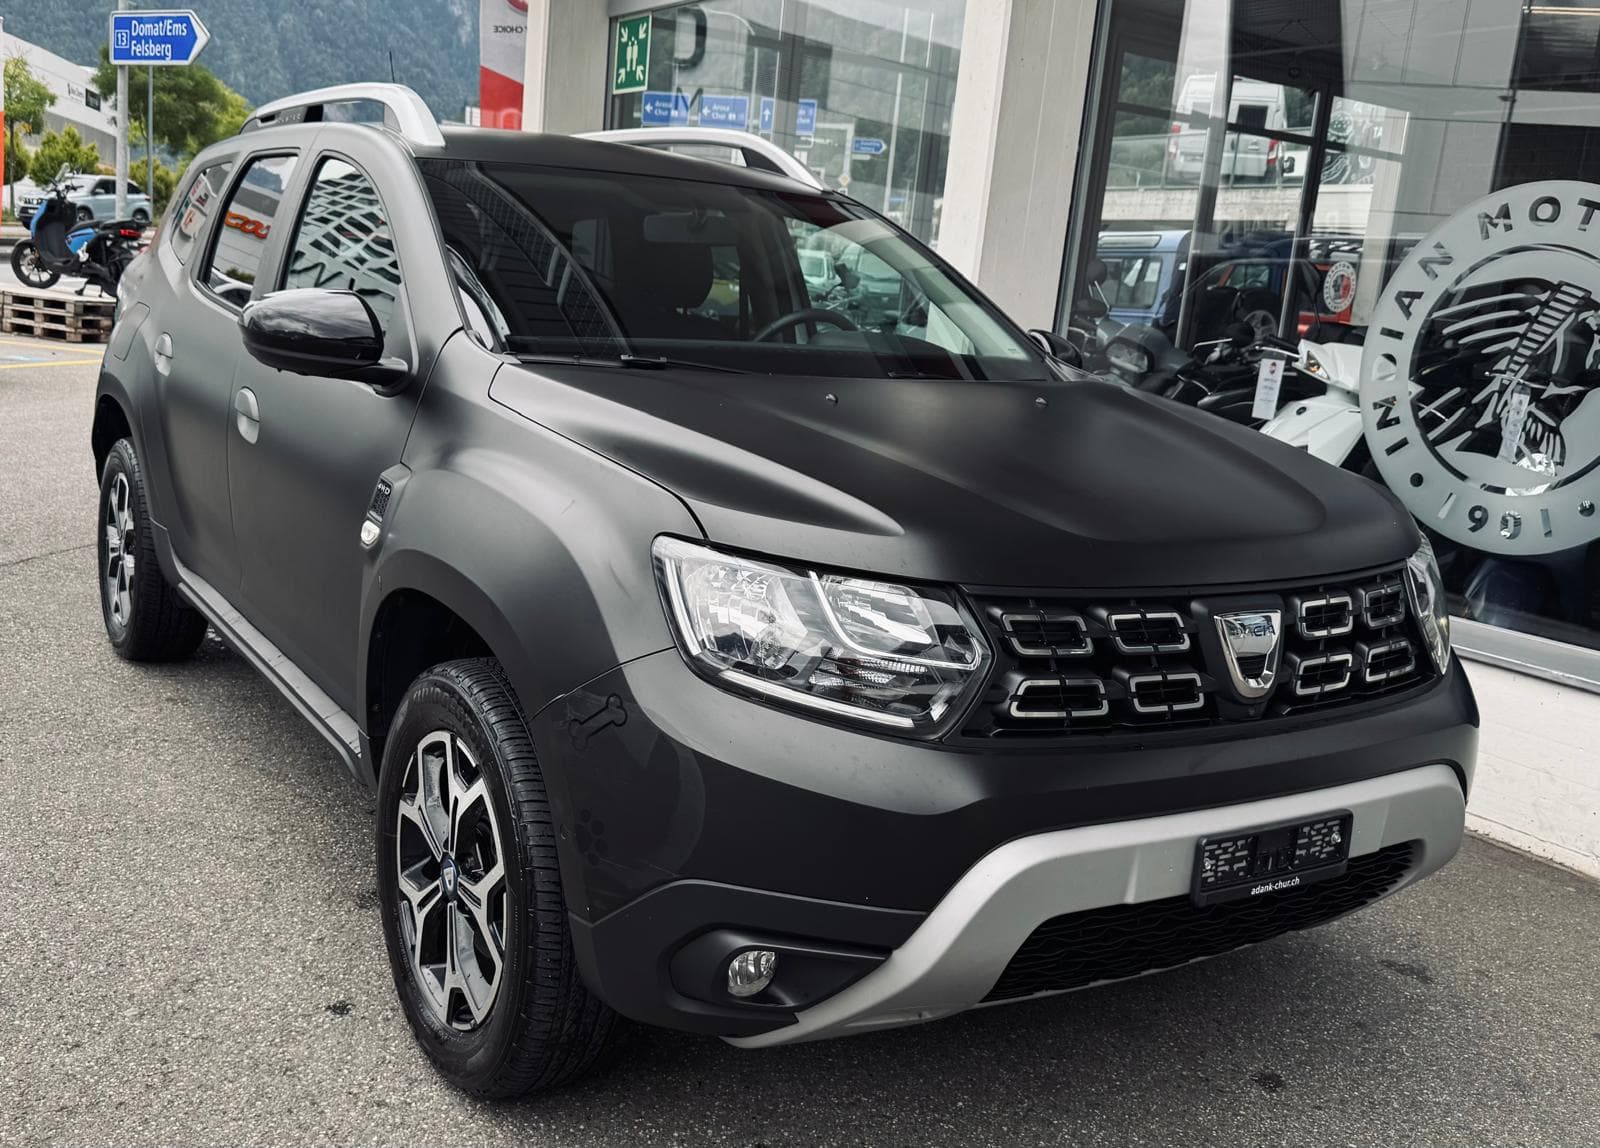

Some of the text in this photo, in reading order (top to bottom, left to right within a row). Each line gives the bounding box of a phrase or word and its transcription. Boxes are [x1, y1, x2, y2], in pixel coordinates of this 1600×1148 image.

[131, 19, 187, 36] Domat/Ems
[117, 32, 127, 46] 13
[131, 40, 172, 60] Felsberg
[1373, 241, 1455, 457] INDIAN
[1250, 876, 1300, 895] adank-chur.ch
